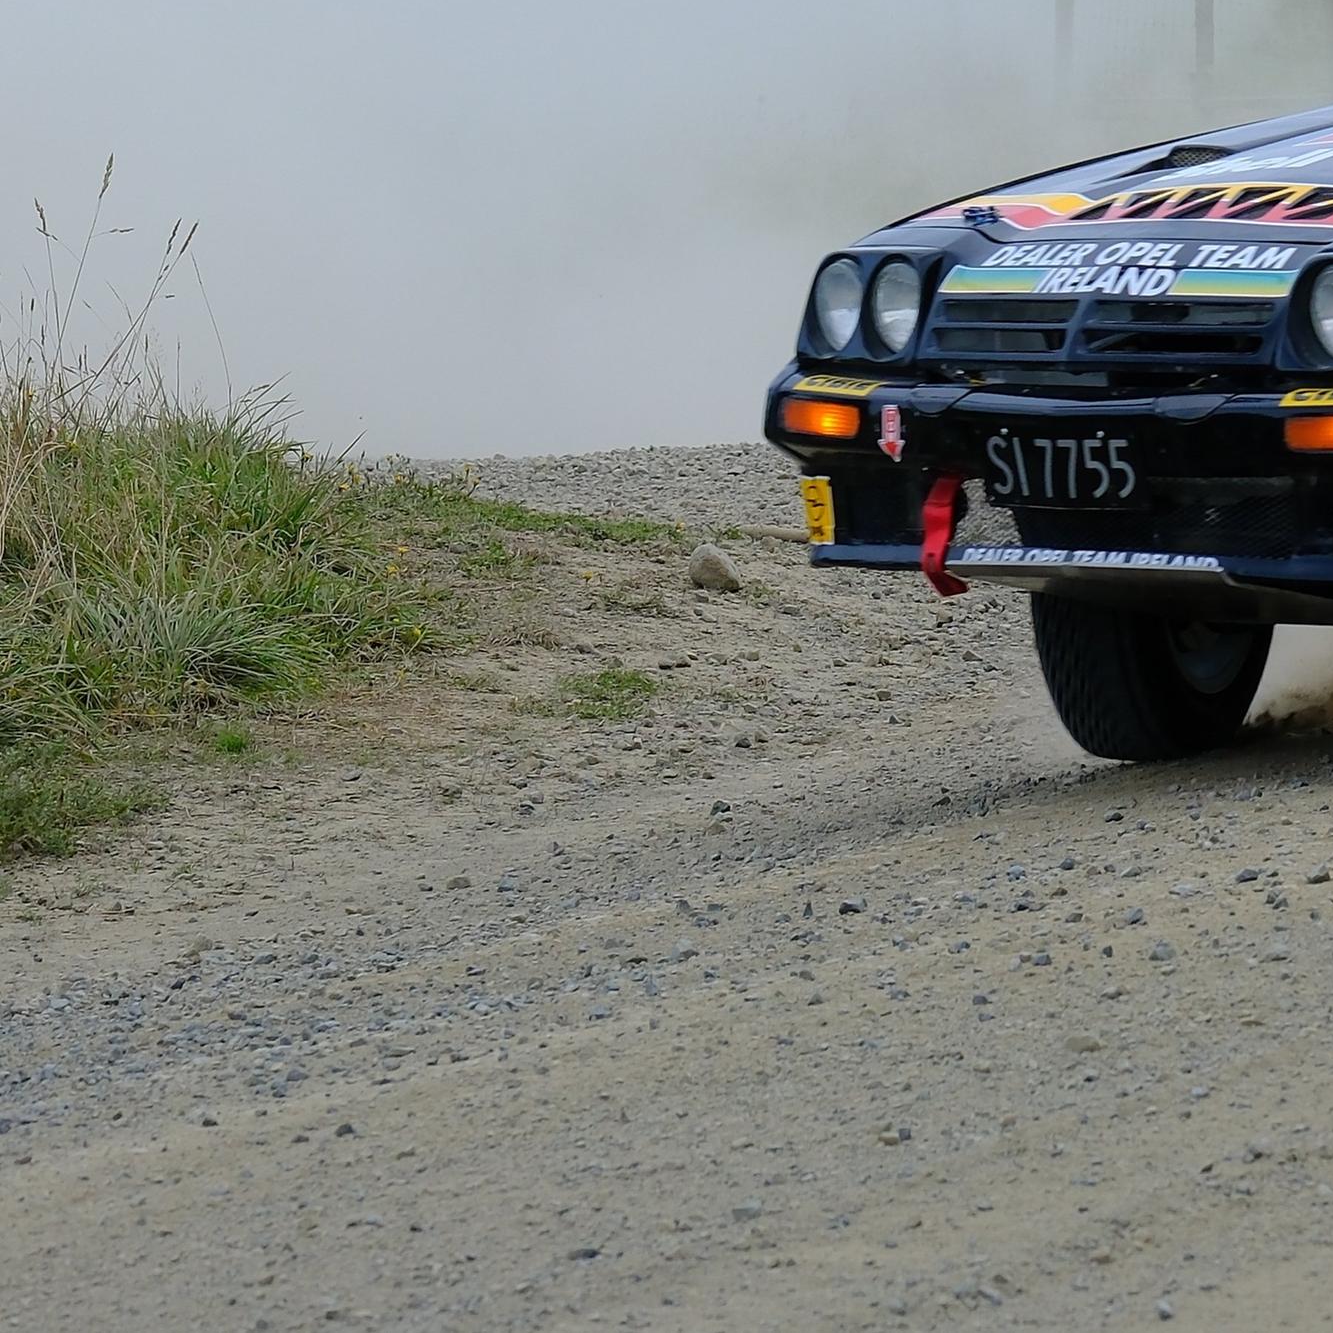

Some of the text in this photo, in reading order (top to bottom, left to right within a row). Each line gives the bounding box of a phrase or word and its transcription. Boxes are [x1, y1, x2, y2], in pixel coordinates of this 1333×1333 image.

[980, 242, 1298, 269] DEALER OPEL TEAM
[1031, 267, 1178, 297] IRELAND
